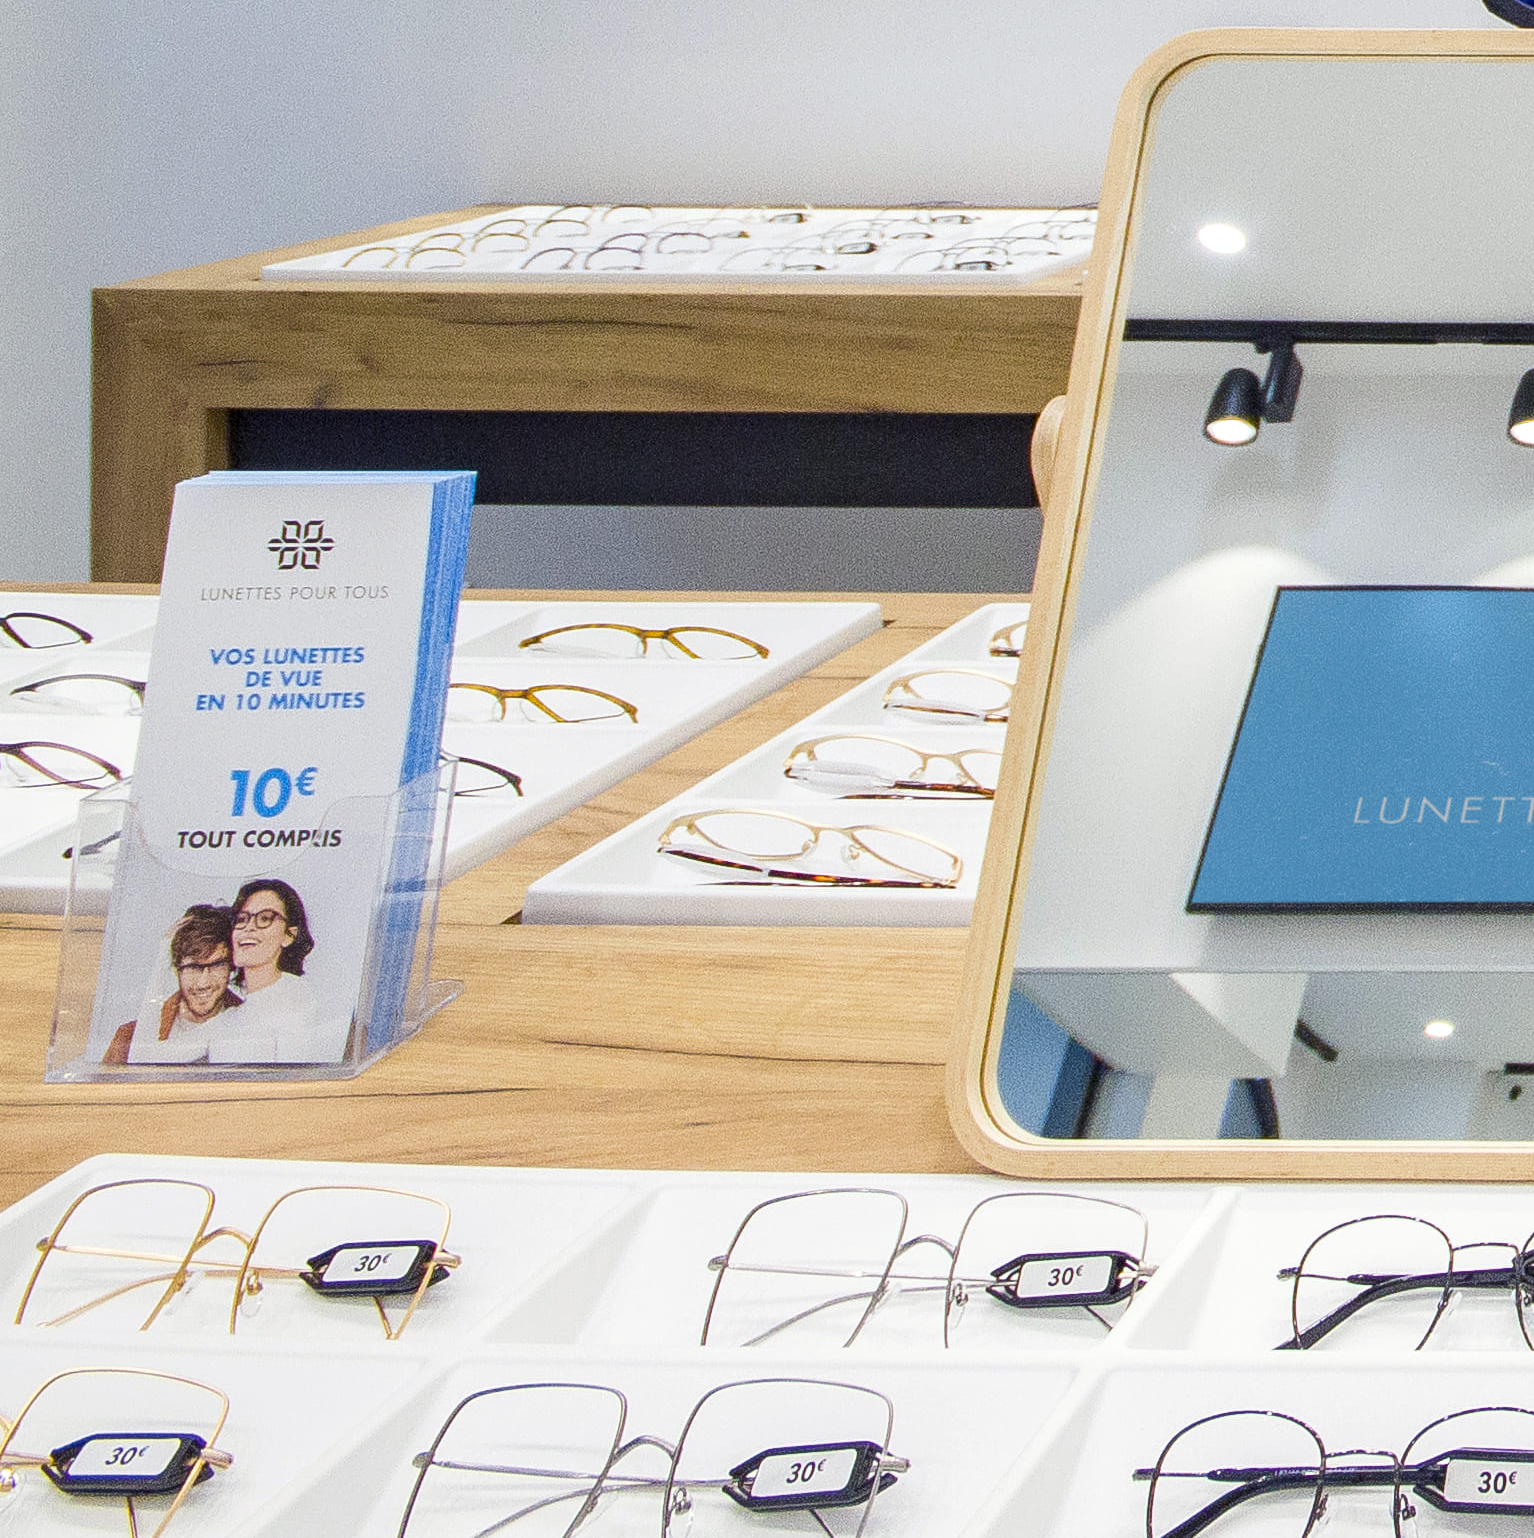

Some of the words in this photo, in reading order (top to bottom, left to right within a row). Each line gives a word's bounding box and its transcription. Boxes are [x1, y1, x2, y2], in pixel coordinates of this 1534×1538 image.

[200, 586, 282, 602] LUNETTES
[289, 585, 337, 601] POUR
[344, 585, 389, 600] TOUS
[210, 648, 255, 666] VOS
[263, 646, 364, 665] LUNETTES
[245, 670, 272, 688] DE
[280, 670, 323, 687] VUE
[196, 694, 225, 711] EN
[236, 693, 262, 711] 10
[268, 691, 365, 710] MINUTES
[231, 767, 317, 818] 10€
[177, 830, 237, 849] TOUT
[353, 1254, 390, 1273] 30€
[1047, 1265, 1083, 1287] 30€
[104, 1446, 149, 1466] 30€
[785, 1459, 826, 1484] 30€
[1477, 1471, 1517, 1494] 30€
